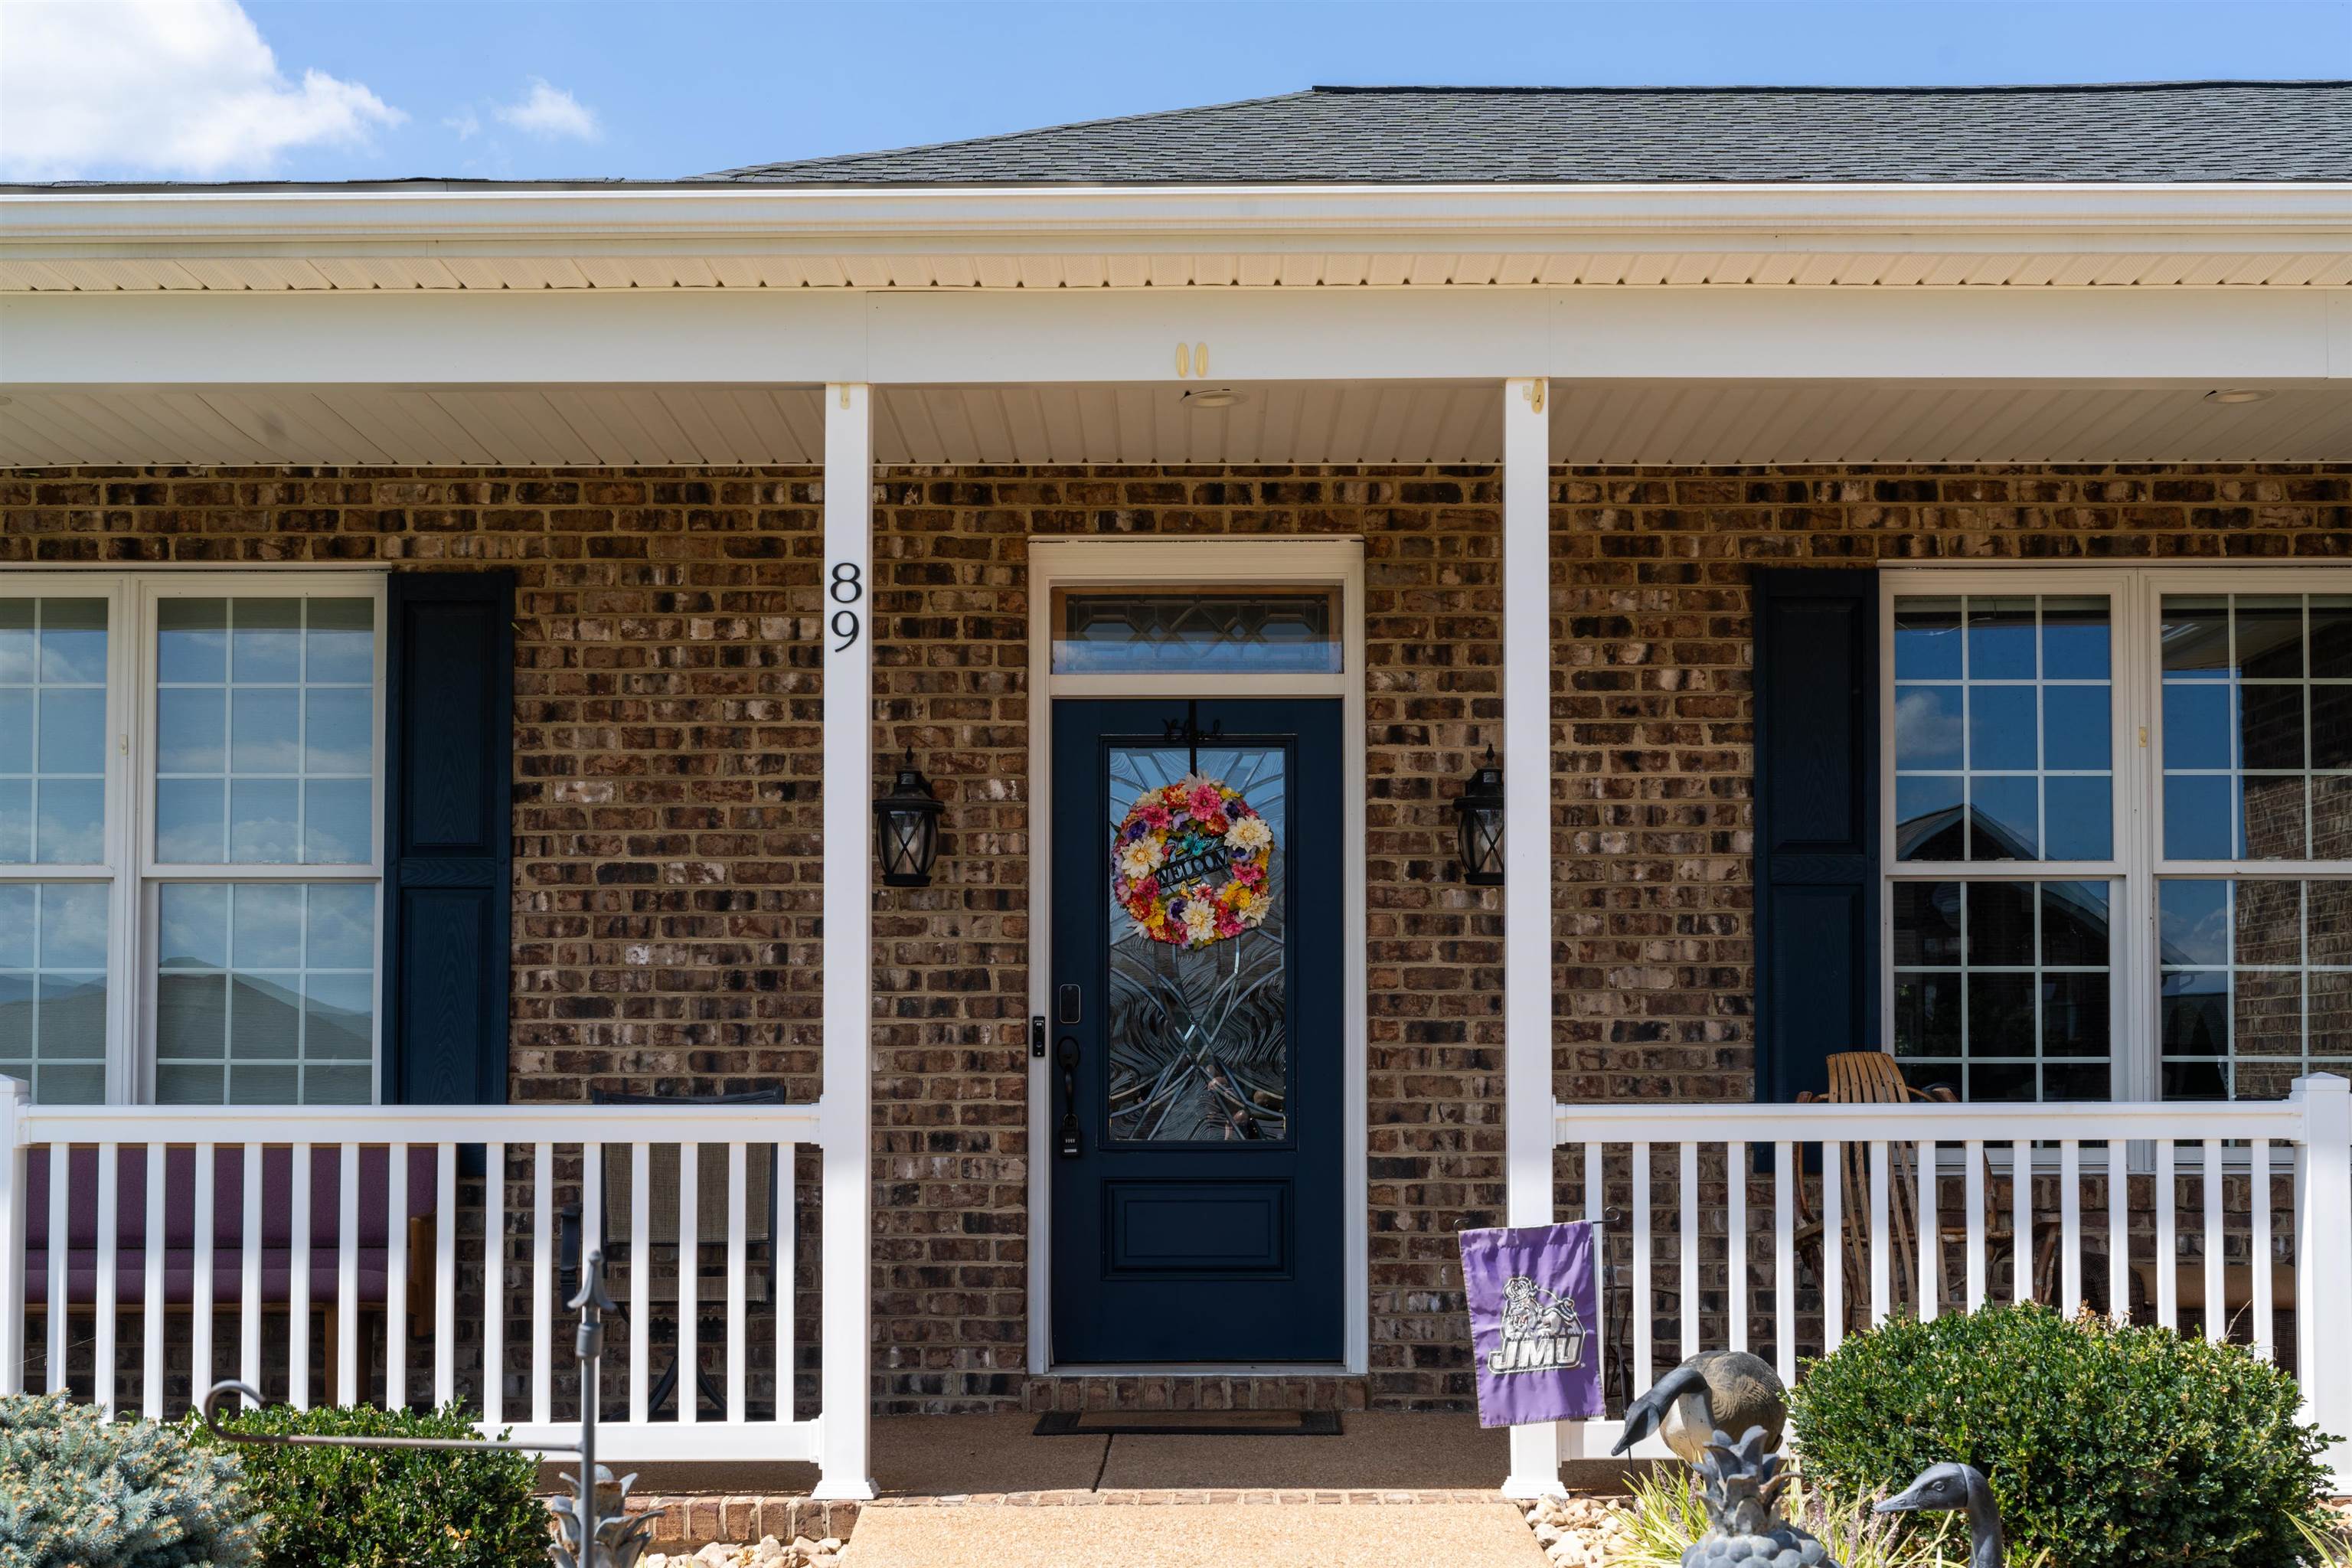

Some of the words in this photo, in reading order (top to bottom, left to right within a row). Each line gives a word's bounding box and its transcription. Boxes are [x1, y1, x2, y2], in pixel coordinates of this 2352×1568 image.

[830, 563, 862, 652] 89
[1155, 846, 1230, 887] WELCOM
[1491, 1337, 1581, 1370] JMU
